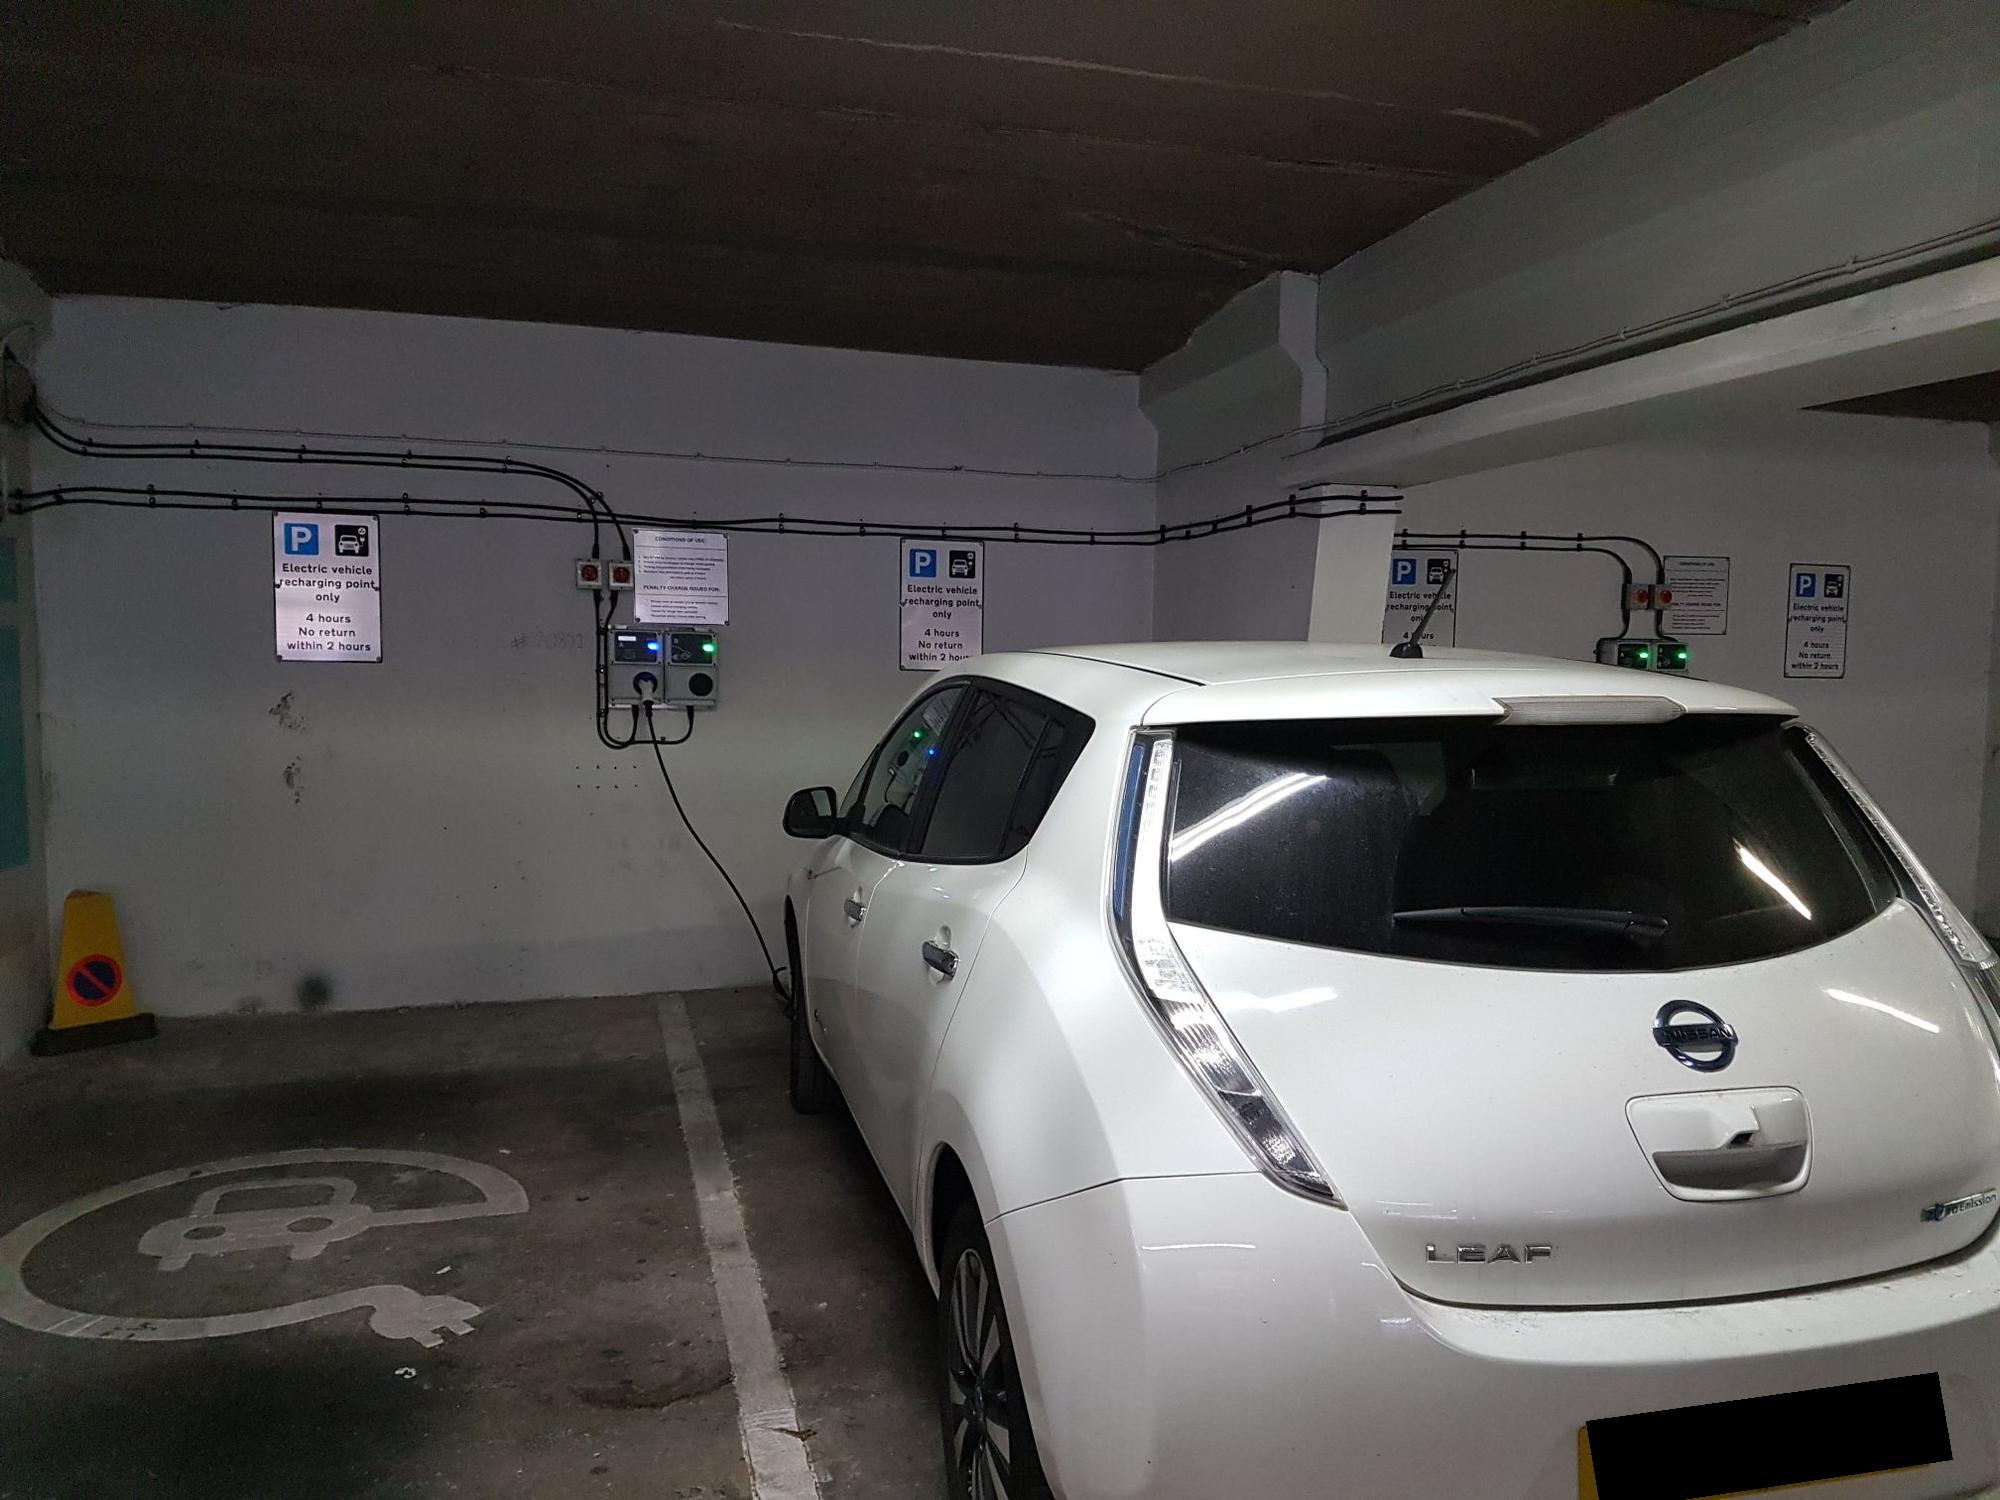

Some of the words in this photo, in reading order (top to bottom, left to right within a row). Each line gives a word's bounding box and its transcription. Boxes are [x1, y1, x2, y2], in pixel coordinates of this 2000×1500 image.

[290, 526, 312, 552] P
[914, 551, 932, 575] P
[282, 563, 328, 574] Electric
[331, 565, 373, 575] vehicle
[1397, 561, 1412, 582] P
[279, 577, 342, 589] recharging
[345, 579, 375, 591] point
[907, 584, 943, 594] Electric
[945, 585, 978, 594] vehicle
[1799, 575, 1812, 595] P
[315, 592, 341, 603] only
[1389, 591, 1420, 600] Electric
[1422, 592, 1451, 600] vehle
[904, 597, 954, 607] recharging
[956, 599, 980, 608] point
[1793, 603, 1819, 612] Electric
[1820, 603, 1844, 612] vehicle
[305, 613, 314, 622] 4
[318, 613, 352, 623] hours
[932, 610, 952, 619] only
[1790, 614, 1826, 623] recharging
[1827, 615, 1845, 623] point
[298, 627, 315, 636] No
[318, 628, 356, 637] return
[924, 628, 931, 637] 4
[933, 628, 960, 637] hours
[1809, 625, 1824, 633] only
[286, 641, 323, 650] within
[326, 641, 334, 650] 2
[338, 642, 371, 651] hours
[918, 640, 932, 649] No
[934, 641, 963, 650] return
[1810, 641, 1830, 649] hours
[908, 652, 938, 661] within
[940, 653, 946, 661] 2
[948, 653, 969, 661] hou
[1798, 651, 1809, 659] No
[1809, 652, 1831, 660] return
[1791, 662, 1813, 670] within
[1814, 662, 1819, 670] 2
[1664, 1024, 1733, 1042] NISSAN
[1425, 1244, 1552, 1265] LEAF
